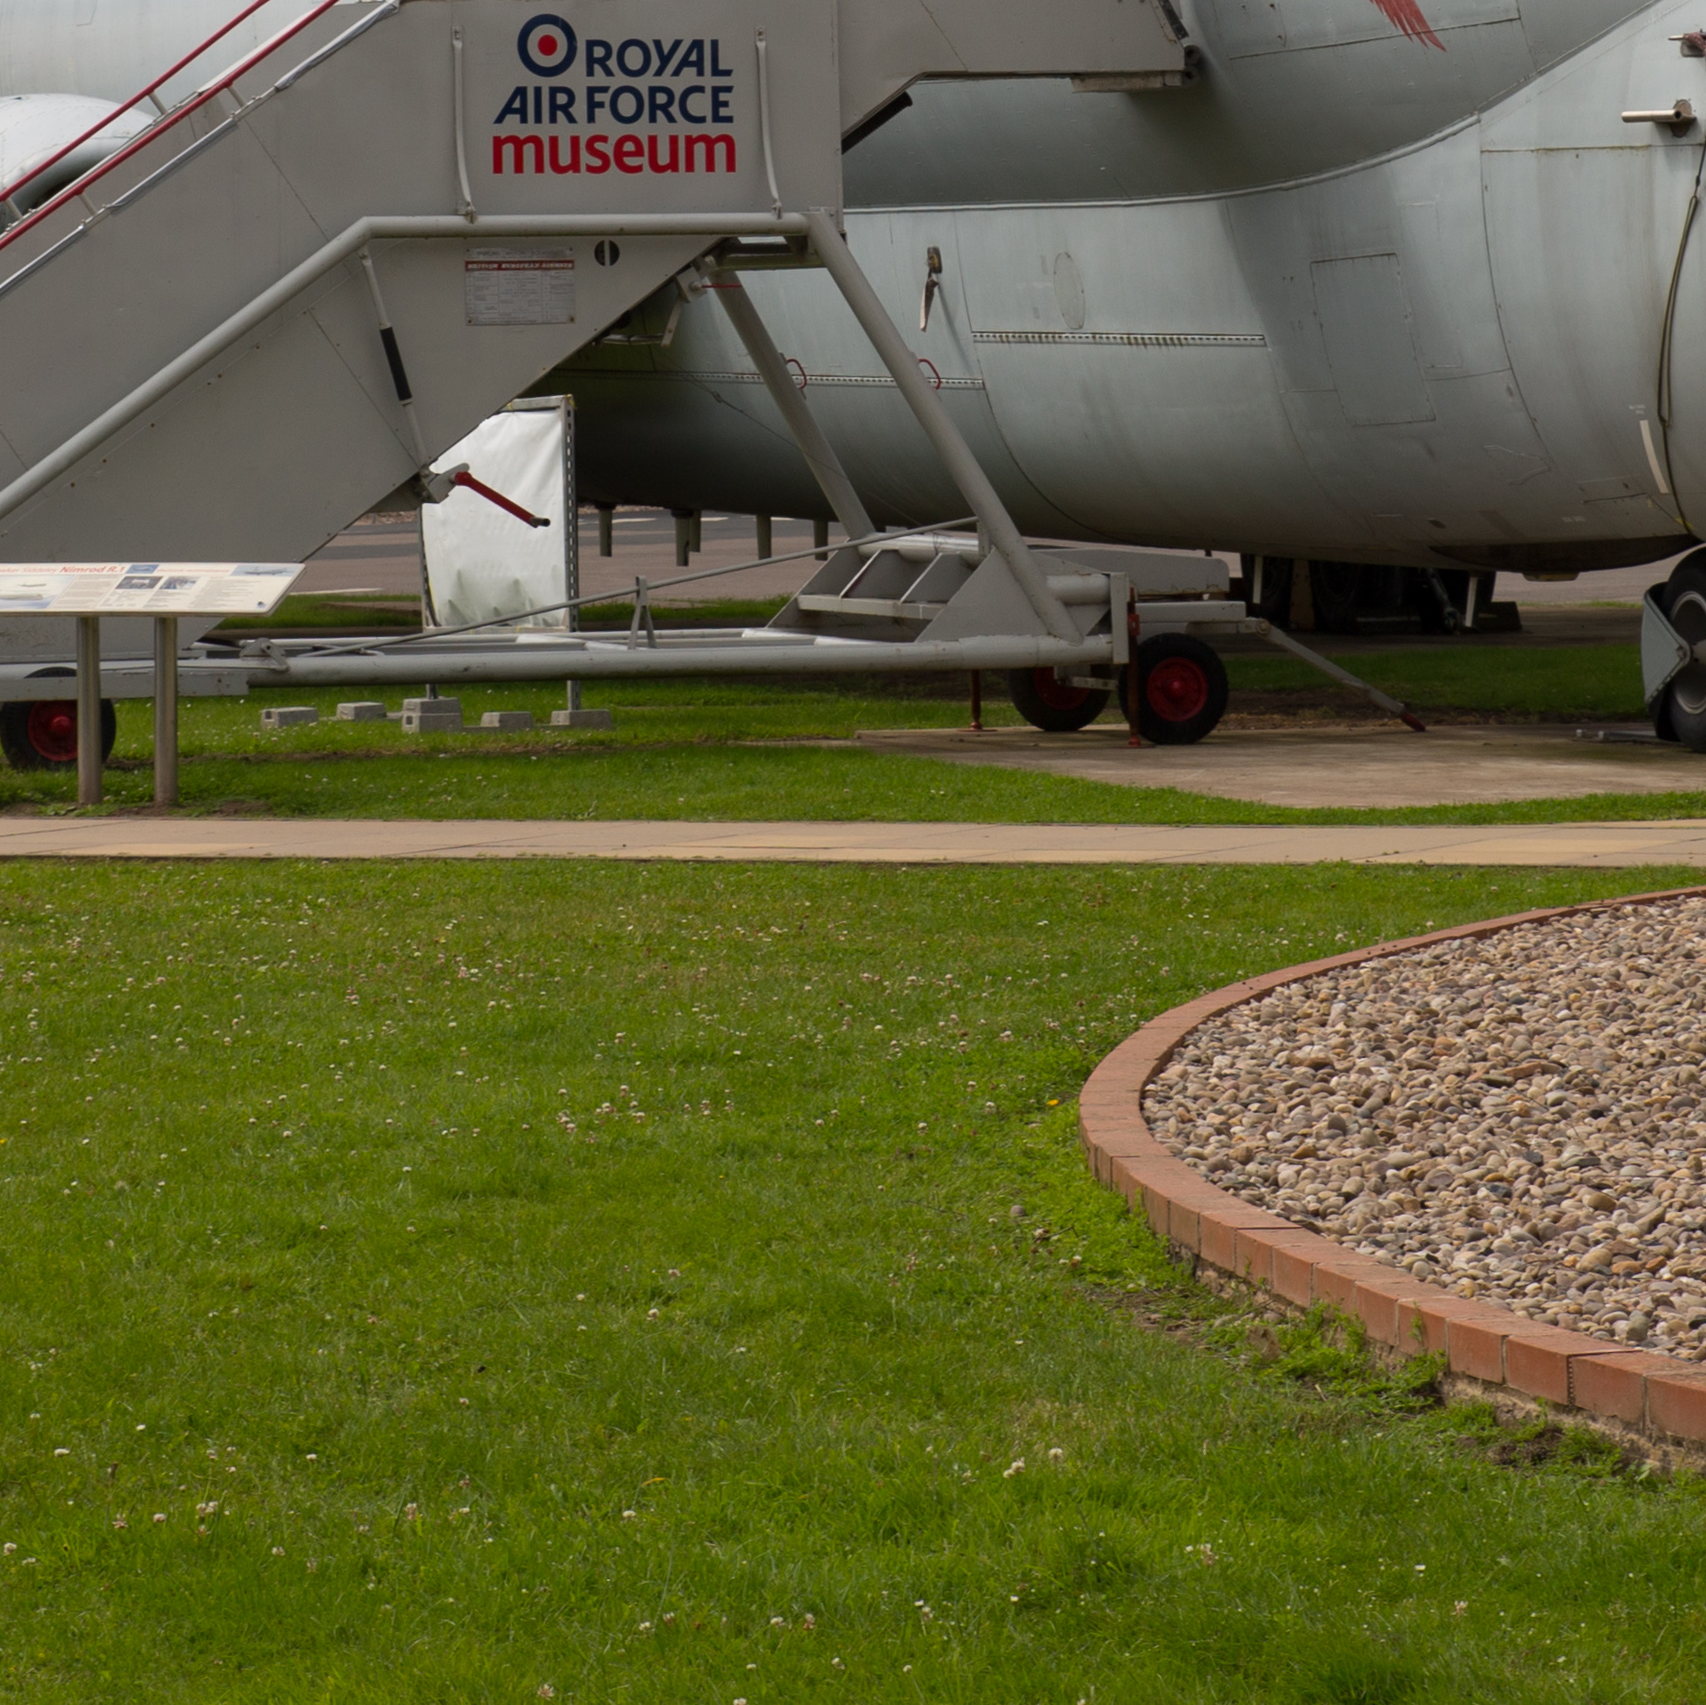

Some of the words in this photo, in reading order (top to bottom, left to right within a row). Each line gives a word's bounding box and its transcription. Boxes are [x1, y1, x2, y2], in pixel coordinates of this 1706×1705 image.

[585, 38, 734, 77] ROYAL
[493, 85, 576, 124] AIR
[586, 85, 734, 124] FORCE
[492, 133, 737, 174] museum
